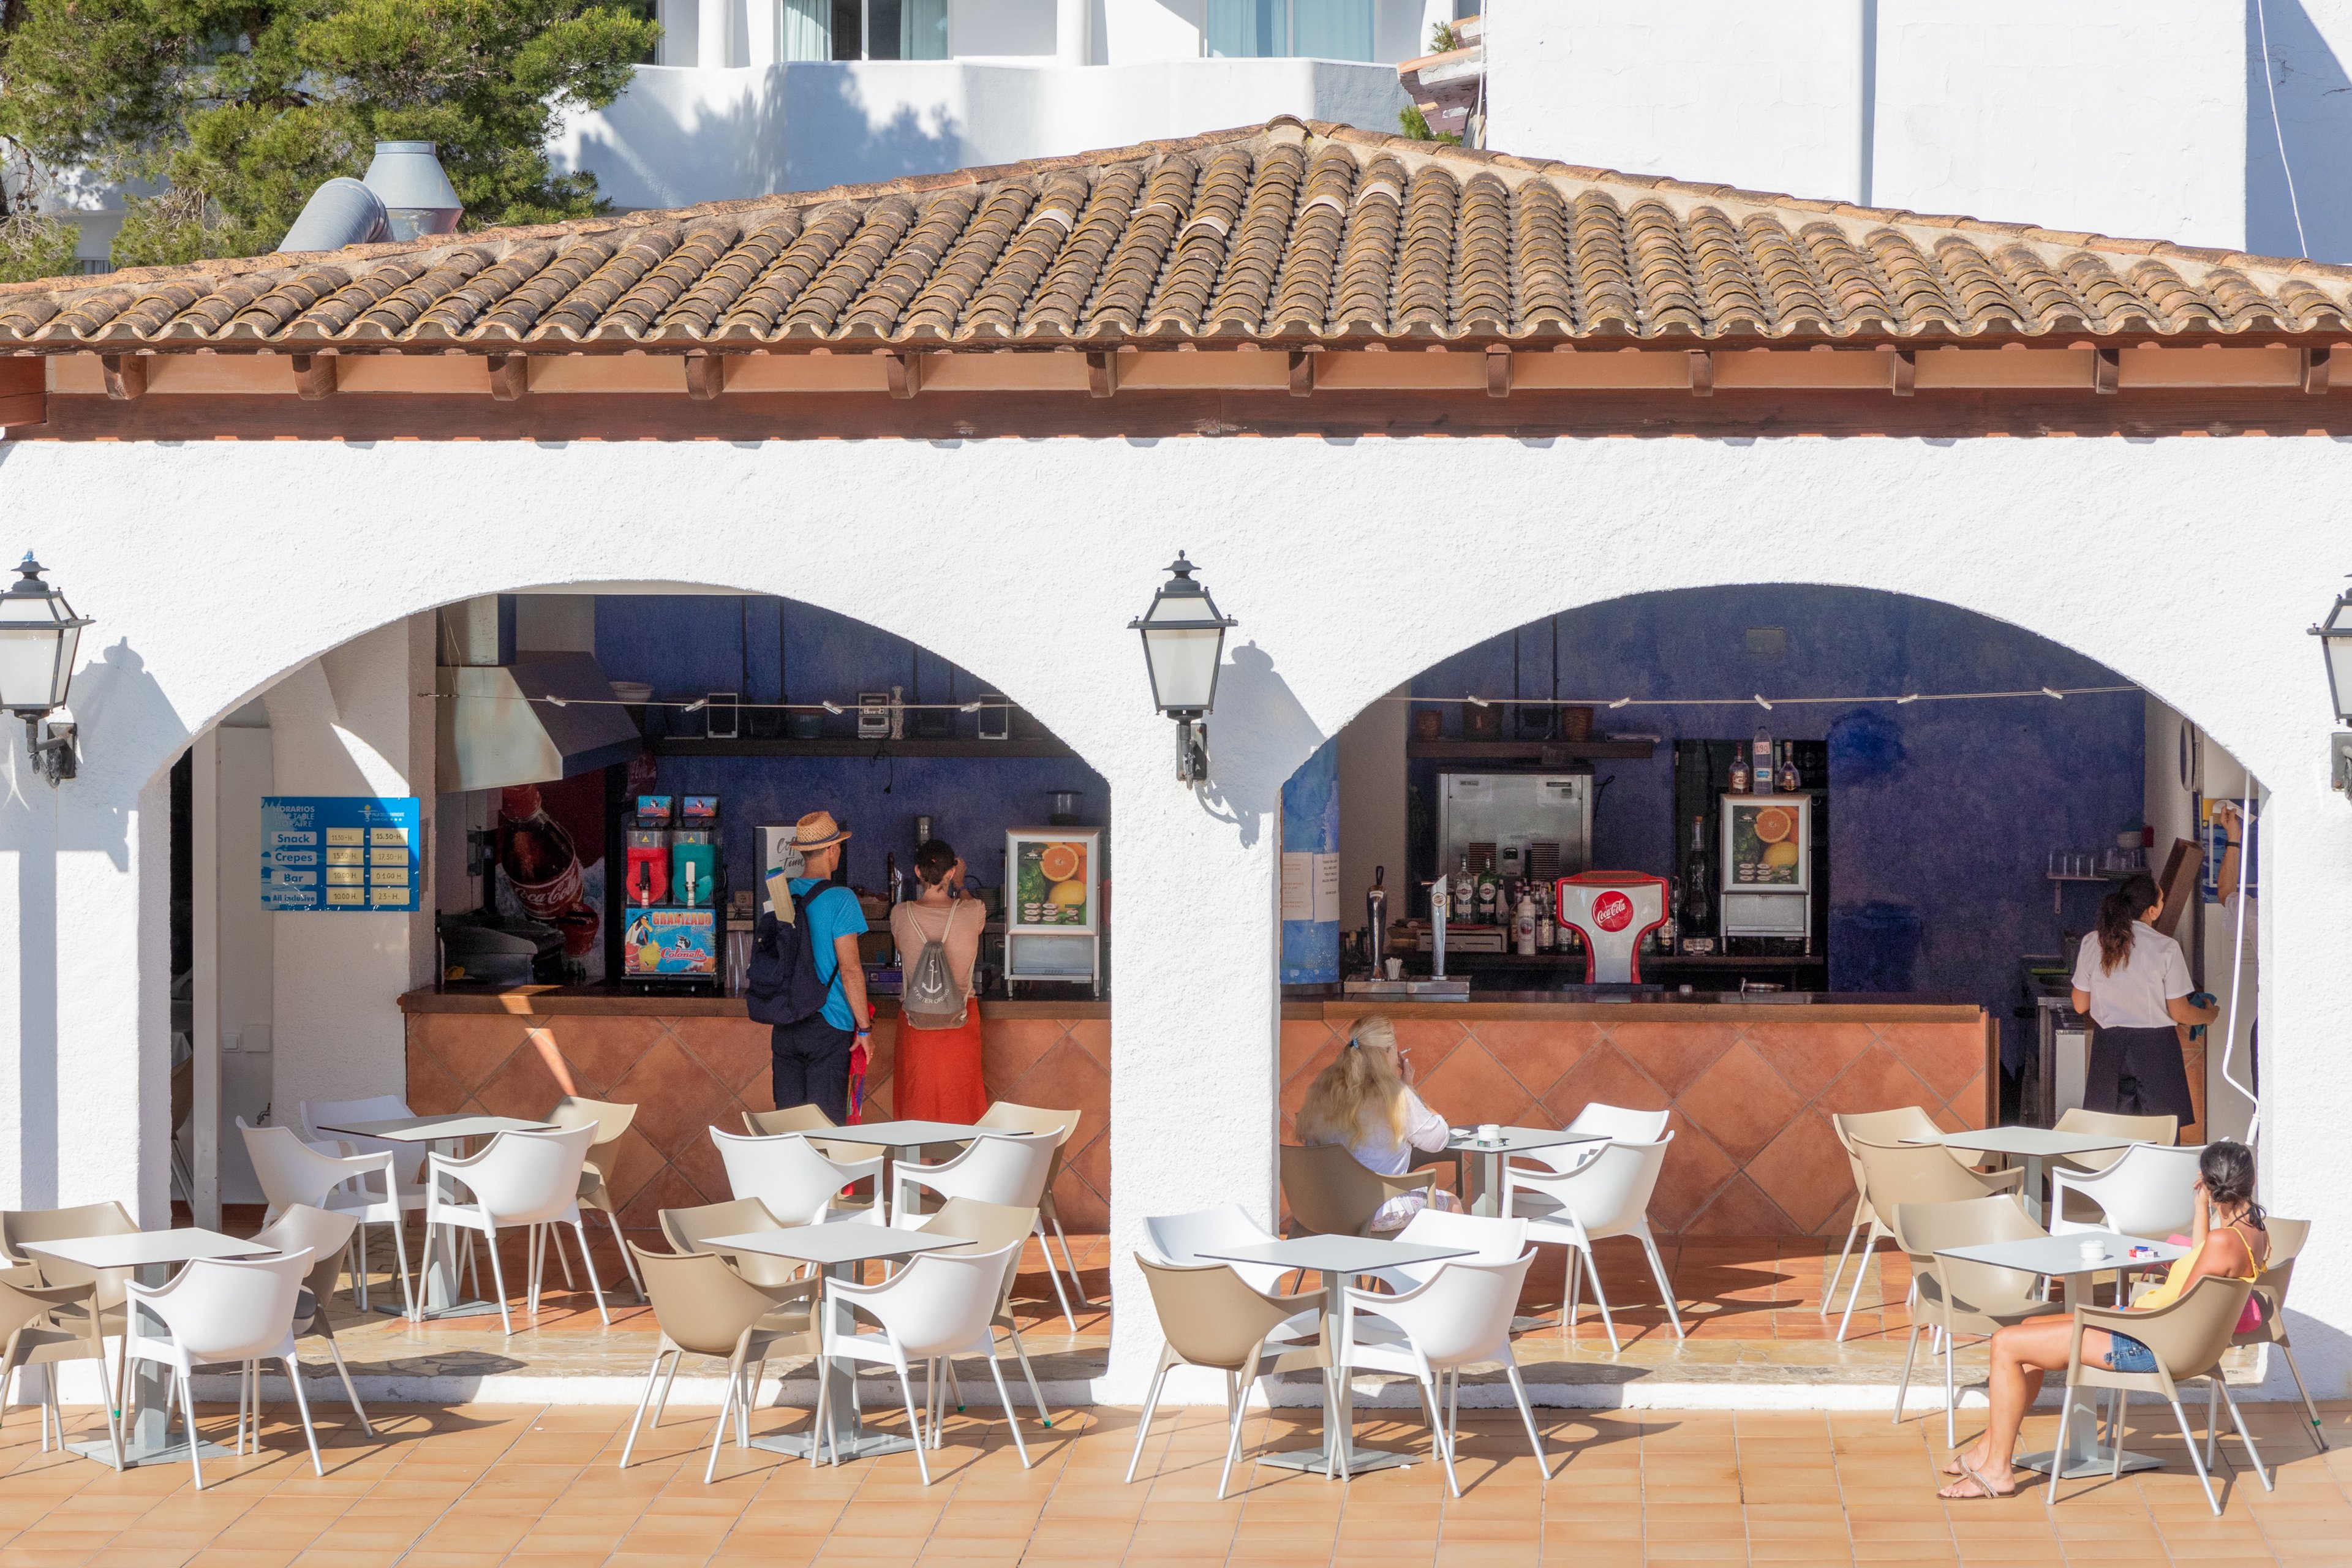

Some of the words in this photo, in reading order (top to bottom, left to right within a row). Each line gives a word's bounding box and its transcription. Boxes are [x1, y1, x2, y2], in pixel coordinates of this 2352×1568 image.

[277, 834, 310, 843] Snack
[275, 853, 312, 864] Crepes
[284, 873, 304, 882] Bar
[652, 912, 713, 925] GRANIZADO
[660, 948, 707, 963] Colonette
